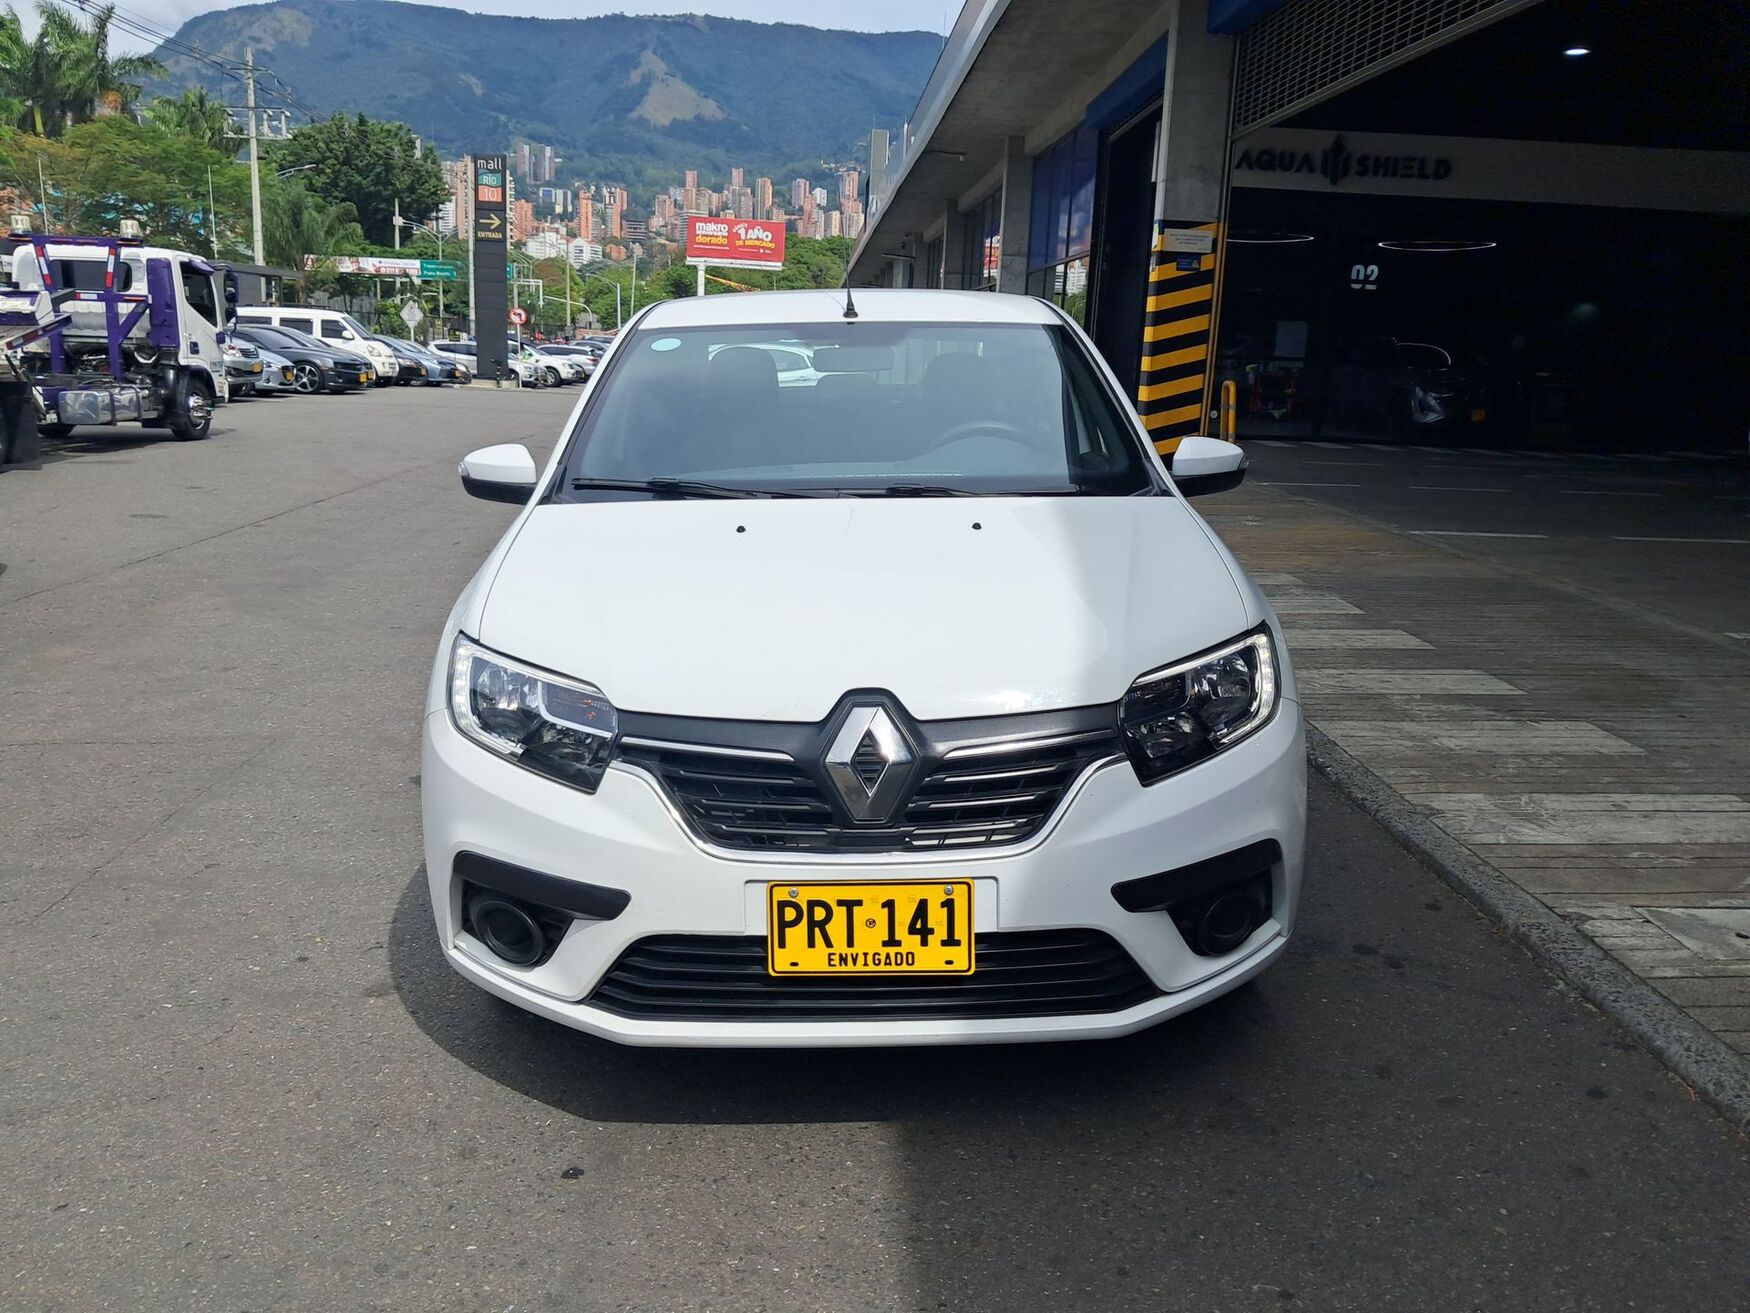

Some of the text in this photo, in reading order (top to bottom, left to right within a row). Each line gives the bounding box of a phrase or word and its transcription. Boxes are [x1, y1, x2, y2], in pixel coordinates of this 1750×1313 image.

[477, 157, 502, 170] mall
[1234, 148, 1453, 181] AQUA SHIELD
[483, 188, 497, 201] 10
[696, 222, 728, 232] makro
[737, 226, 772, 242] 1 AÑO
[696, 235, 728, 244] dorado
[745, 240, 776, 248] MERCADO
[1350, 264, 1379, 290] 02
[776, 897, 962, 949] PRT 141
[827, 951, 915, 967] ENVIGADO
